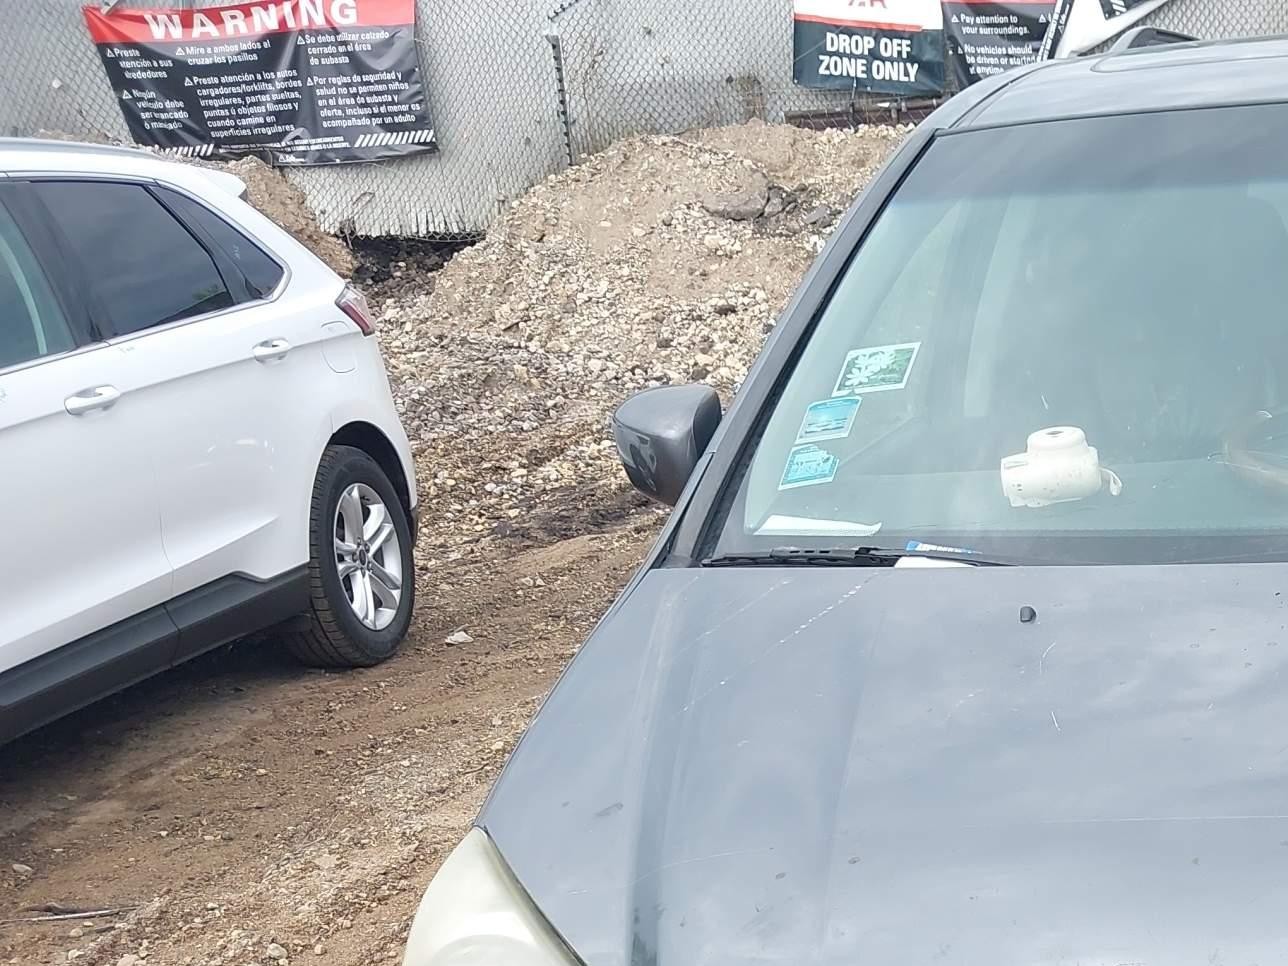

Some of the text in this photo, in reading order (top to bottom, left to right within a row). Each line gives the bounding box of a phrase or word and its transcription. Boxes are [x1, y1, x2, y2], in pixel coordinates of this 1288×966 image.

[144, 0, 357, 40] WARNING
[960, 14, 1018, 24] Pay attention to
[961, 26, 977, 34] your
[825, 31, 911, 58] DROP OFF
[964, 43, 1032, 54] No vehicles should
[818, 55, 918, 82] ZONE ONLY
